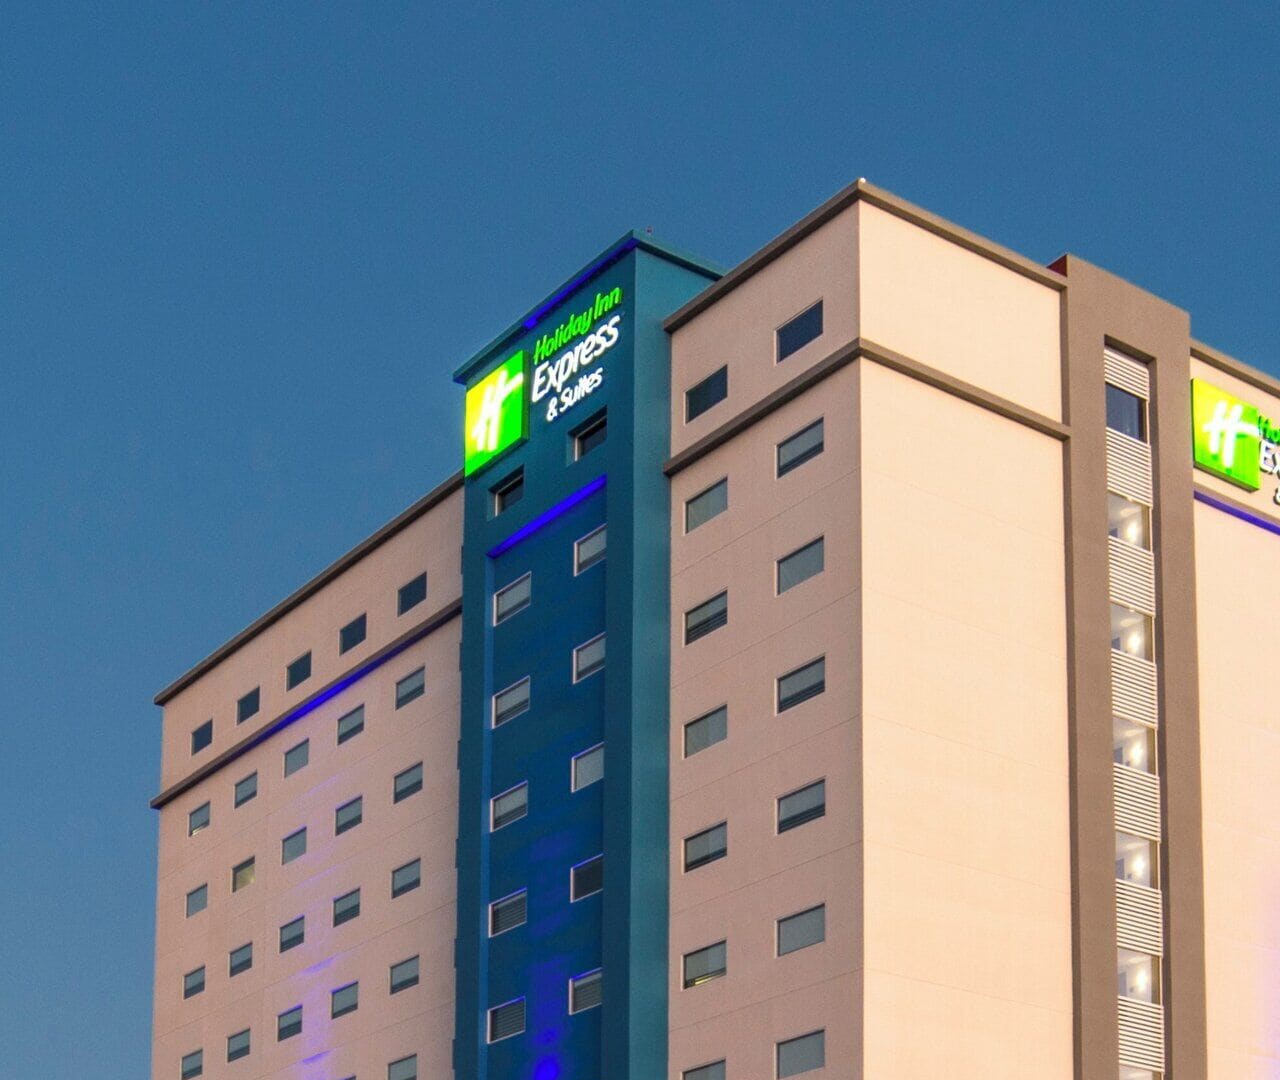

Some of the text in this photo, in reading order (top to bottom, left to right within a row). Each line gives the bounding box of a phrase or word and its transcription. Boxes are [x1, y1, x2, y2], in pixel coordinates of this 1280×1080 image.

[531, 315, 620, 403] Express
[532, 287, 622, 366] Holiday Inn
[546, 367, 604, 423] & Suites
